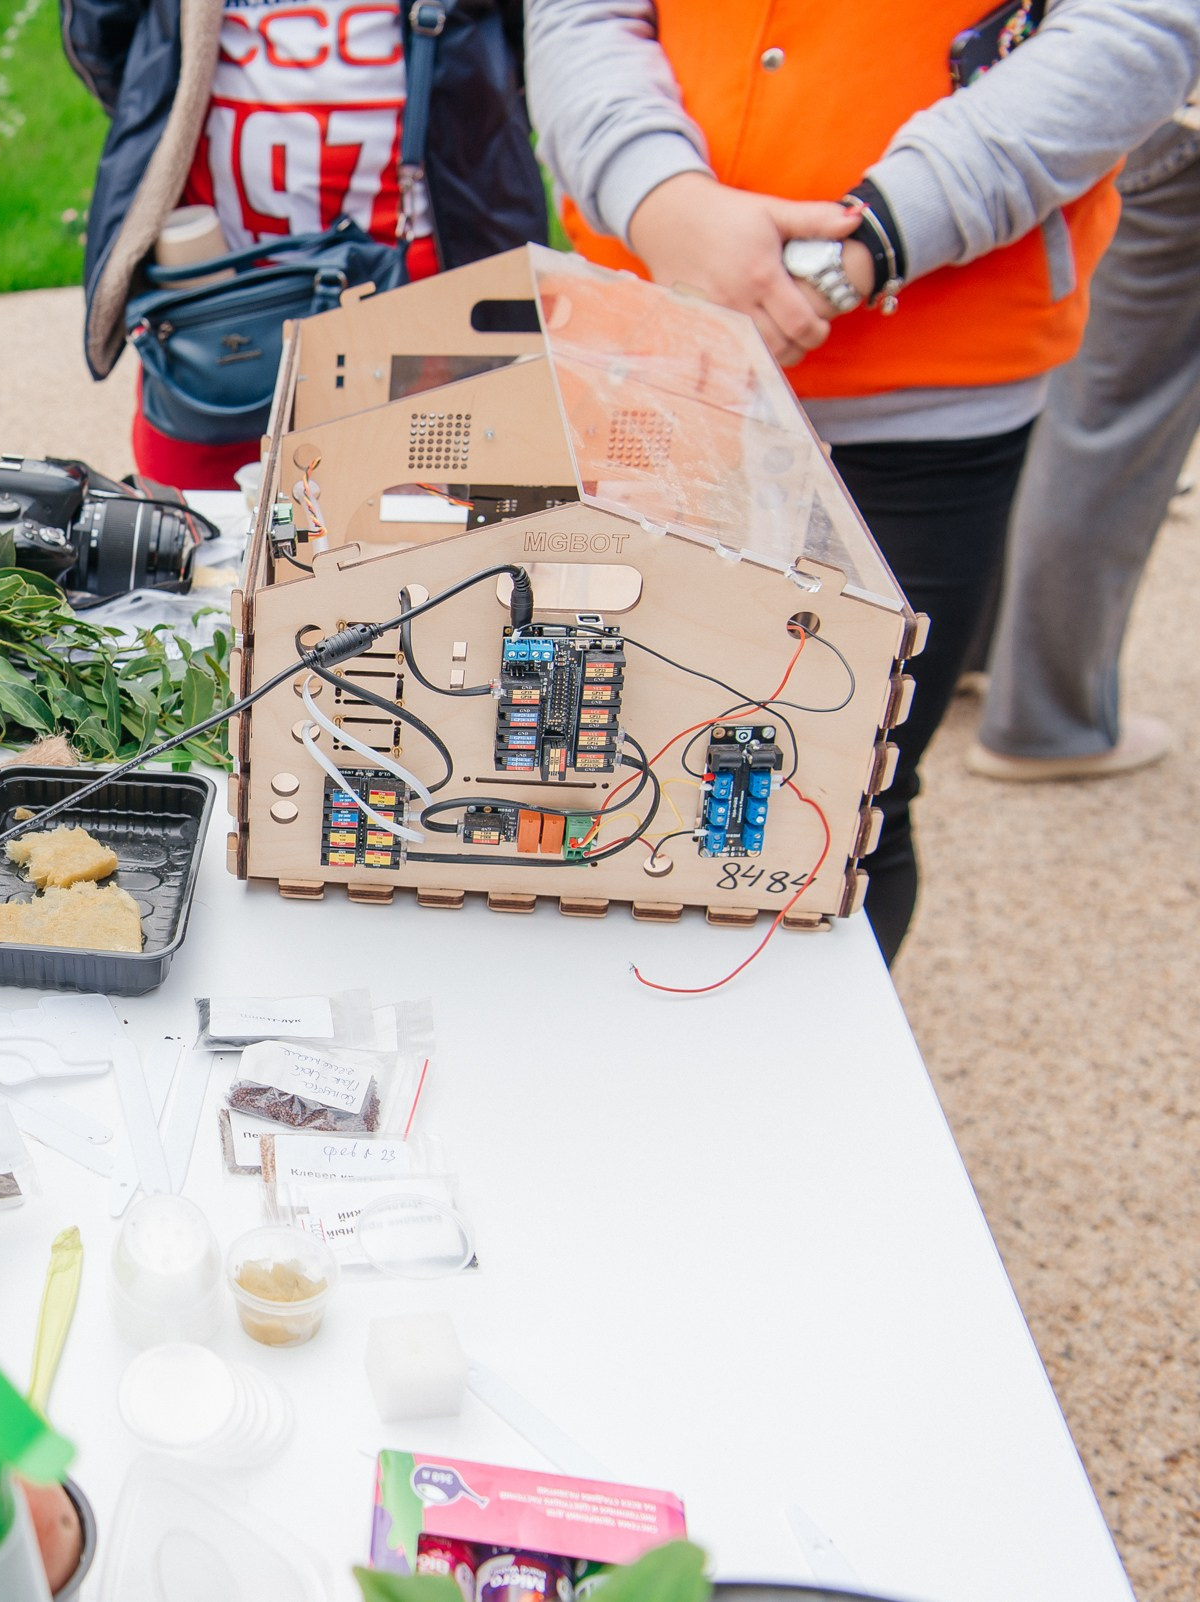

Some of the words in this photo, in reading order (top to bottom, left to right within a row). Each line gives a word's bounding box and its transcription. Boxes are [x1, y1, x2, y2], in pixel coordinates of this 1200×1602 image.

[523, 531, 630, 554] MGBOT
[716, 862, 817, 893] 8484
[490, 1573, 546, 1592] Micro
